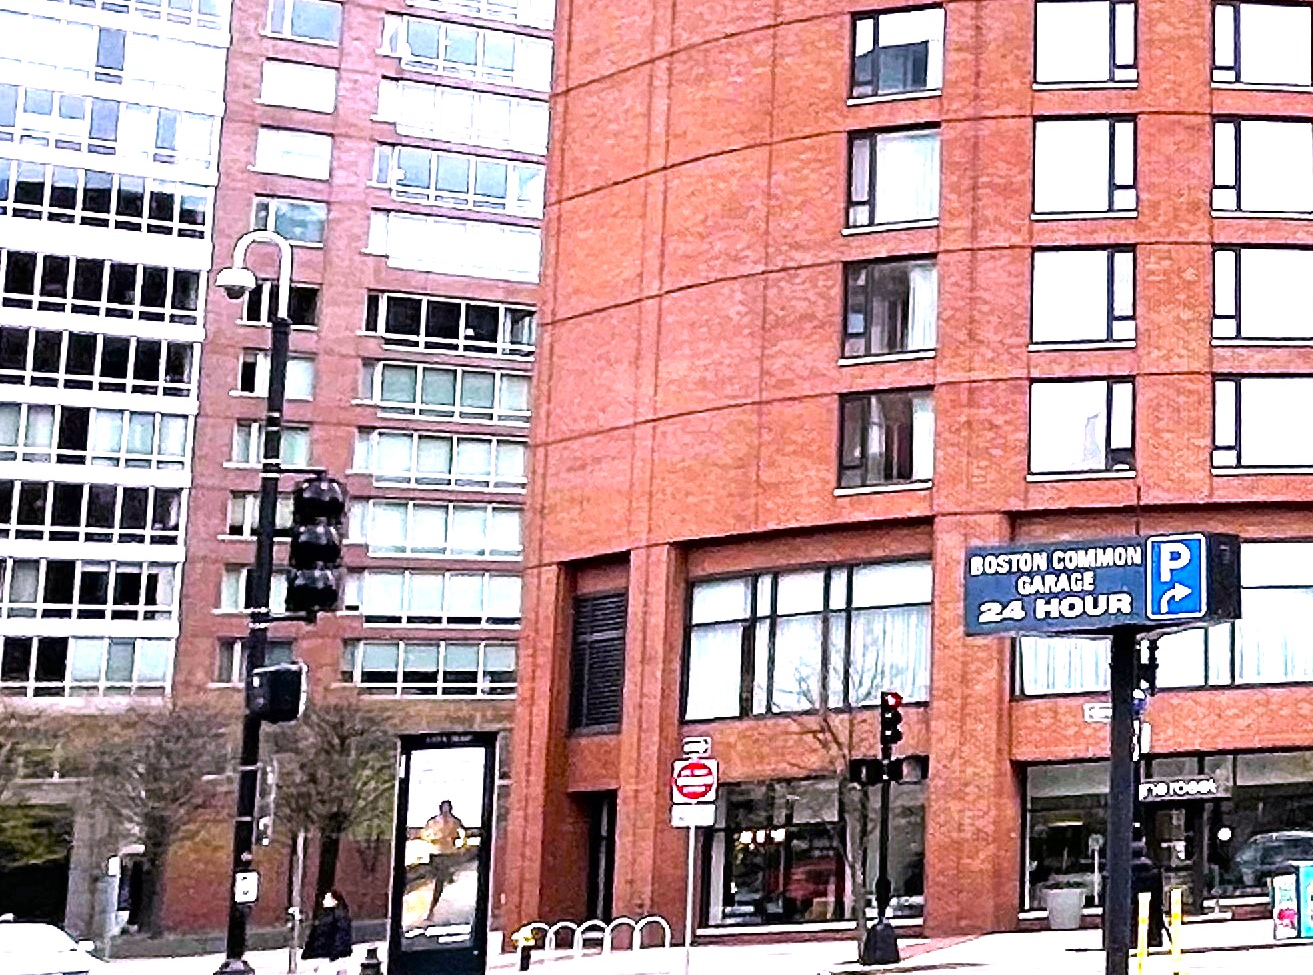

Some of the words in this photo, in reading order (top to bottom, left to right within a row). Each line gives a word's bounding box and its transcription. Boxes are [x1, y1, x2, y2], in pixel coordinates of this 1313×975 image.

[969, 552, 1047, 576] BOSTON
[1052, 546, 1142, 569] COMMON
[1160, 542, 1191, 582] P
[1017, 572, 1094, 595] GARAGE
[978, 600, 1025, 624] 24
[1035, 593, 1132, 619] HOUR
